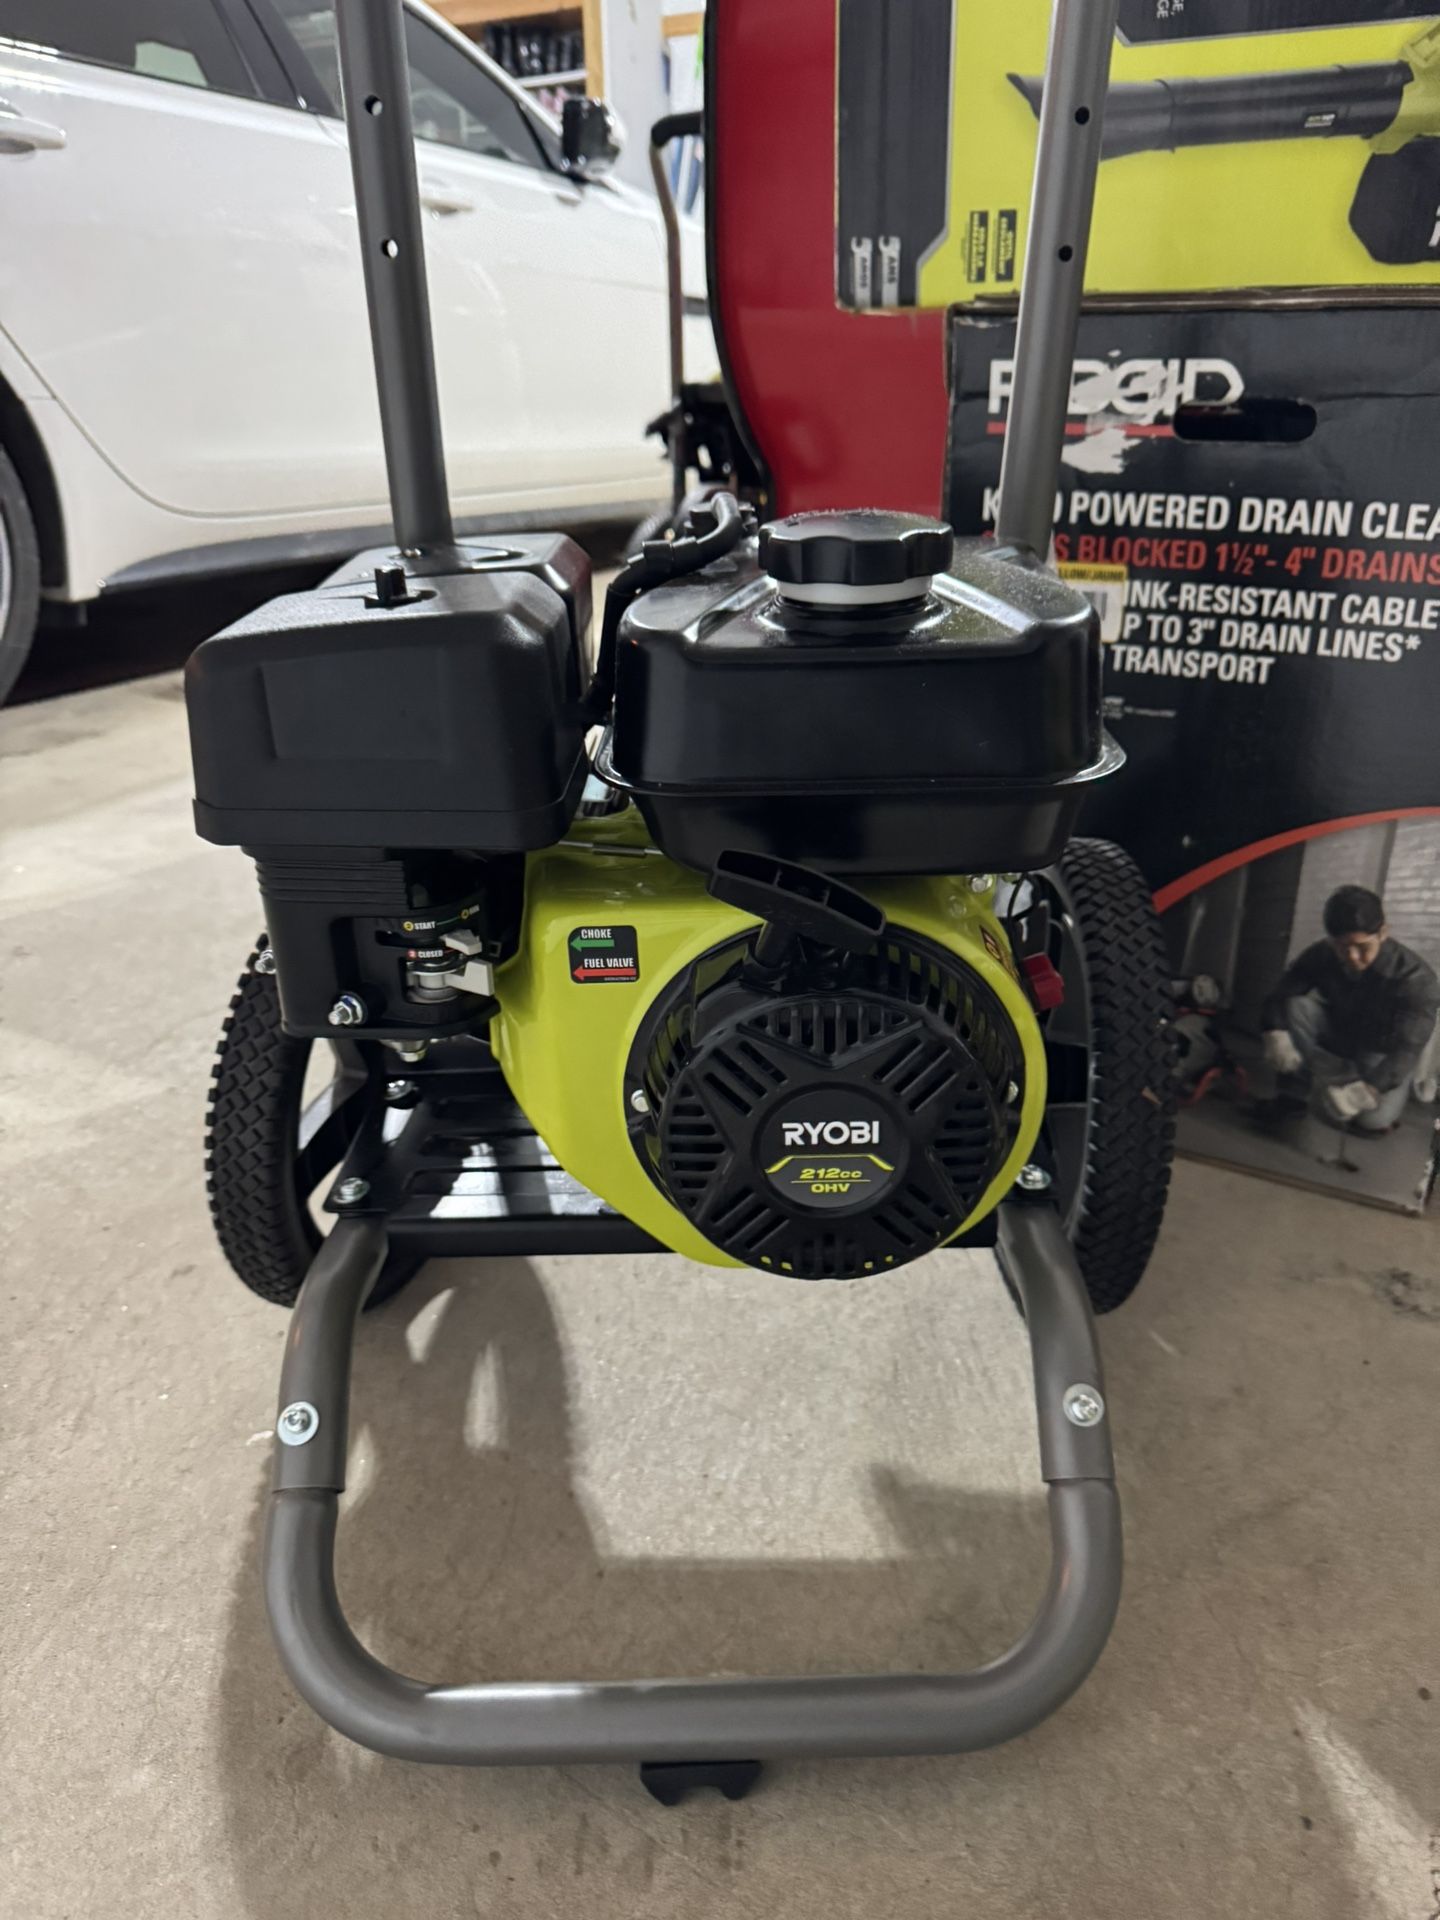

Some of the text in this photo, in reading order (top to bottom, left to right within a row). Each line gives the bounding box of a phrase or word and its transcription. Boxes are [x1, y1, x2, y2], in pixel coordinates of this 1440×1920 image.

[988, 358, 1245, 416] RDGID
[1069, 491, 1230, 532] POWERED
[1238, 497, 1354, 537] DRAIN
[1077, 534, 1207, 570] BLOCKED
[1321, 547, 1440, 586] DRAINS
[1122, 580, 1440, 630] INK-RESISTANT CABLE
[1122, 612, 1142, 640] P
[1147, 614, 1183, 643] TO
[1219, 619, 1312, 655] DRAIN
[1111, 644, 1276, 685] TRANSPORT
[414, 921, 436, 930] START
[581, 928, 612, 939] CHOKE
[417, 949, 444, 959] CLOSED
[583, 957, 635, 968] FUEL VALVE
[782, 1120, 880, 1146] RYOBI
[799, 1167, 863, 1180] 212cc
[810, 1183, 850, 1193] OHV
